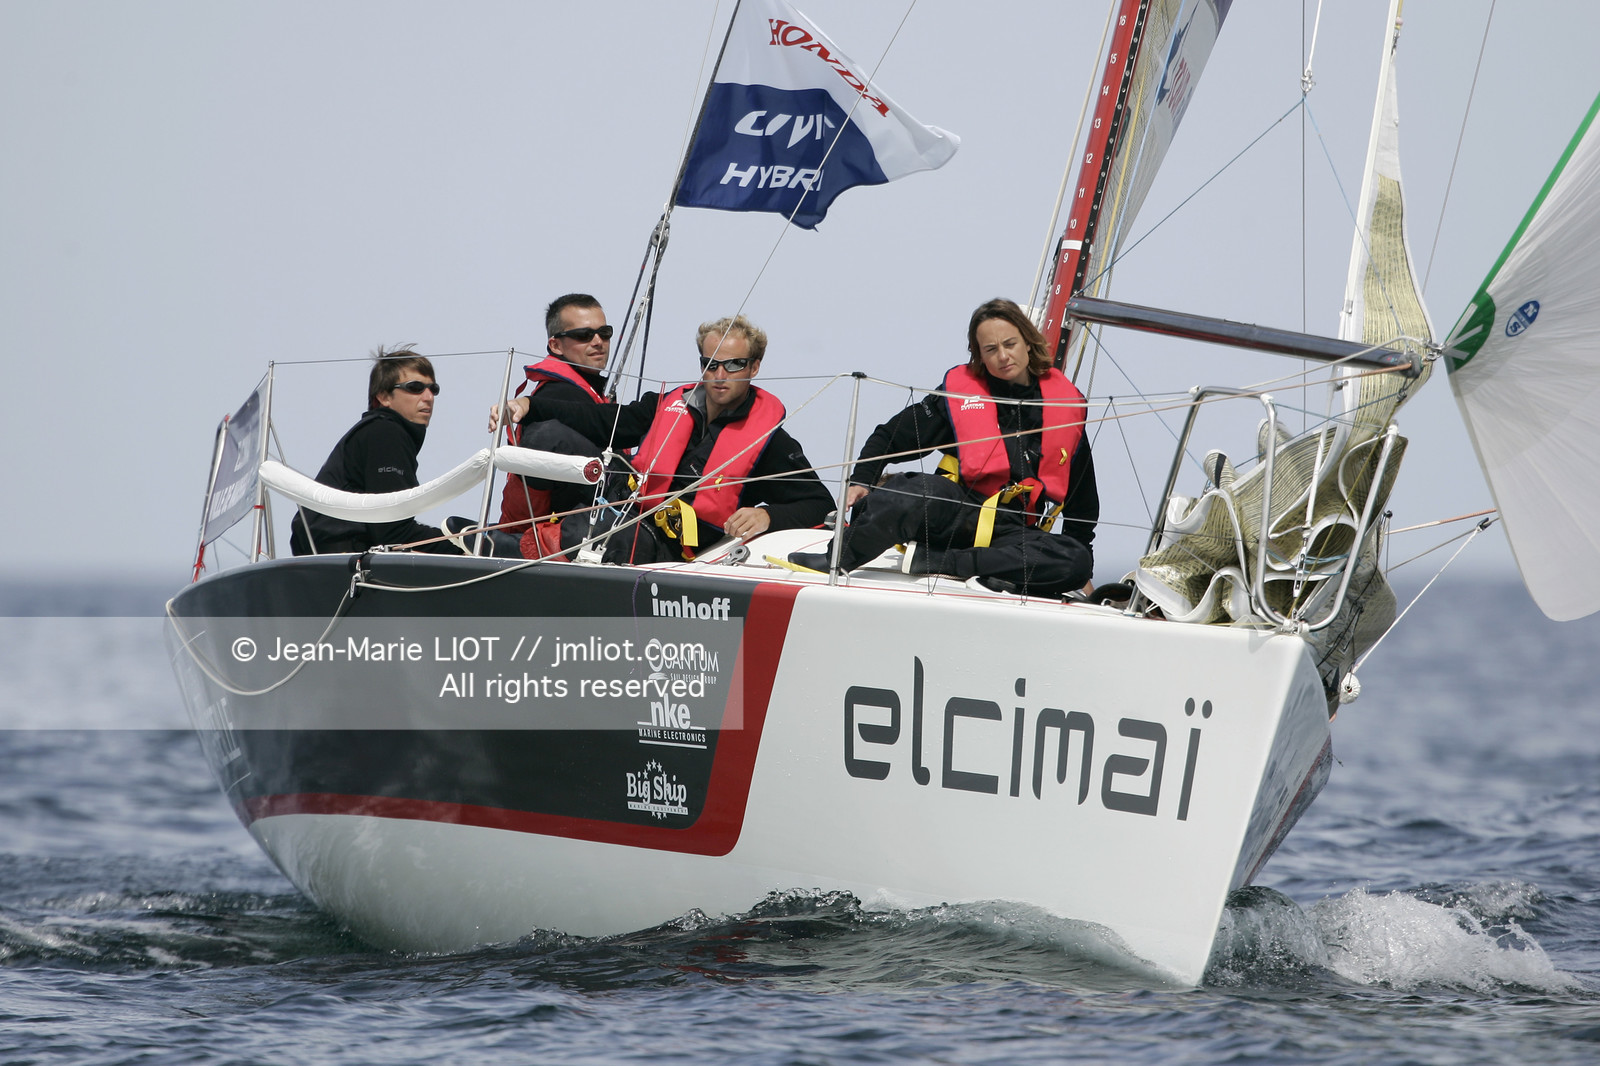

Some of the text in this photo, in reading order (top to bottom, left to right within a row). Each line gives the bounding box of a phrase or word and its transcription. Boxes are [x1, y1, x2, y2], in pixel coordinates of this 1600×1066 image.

[1118, 15, 1127, 26] 16
[1109, 53, 1118, 64] 15
[768, 18, 890, 118] HONDA
[1102, 85, 1110, 96] 14
[1094, 118, 1102, 128] 13
[1085, 152, 1094, 163] 12
[1078, 187, 1086, 198] 11
[1069, 218, 1077, 229] 10
[1063, 252, 1069, 263] 9
[1055, 284, 1061, 295] 8
[1047, 319, 1053, 330] 7
[651, 582, 731, 621] imhoff
[650, 693, 691, 730] nke
[638, 728, 706, 743] MARINE ELECTRONICS
[844, 655, 1213, 821] elcimaï
[626, 771, 687, 809] Big Ship
